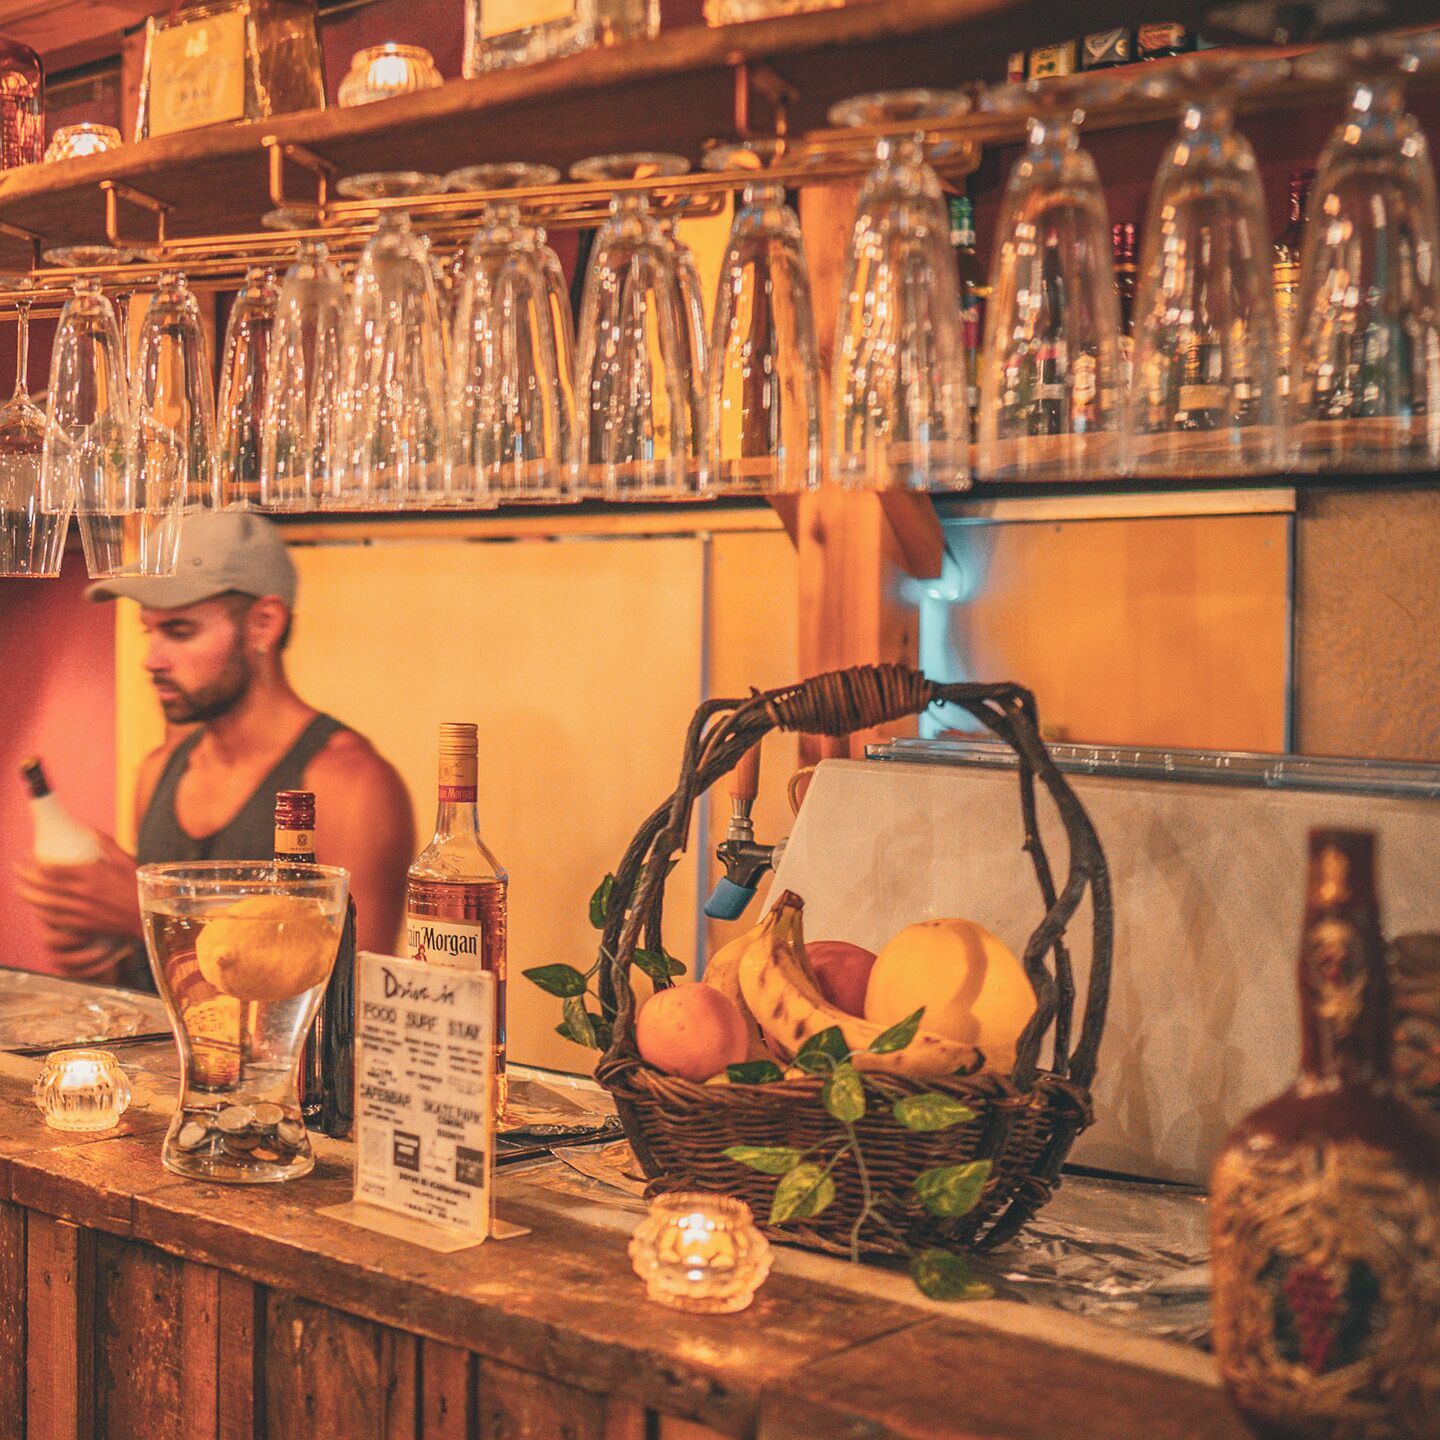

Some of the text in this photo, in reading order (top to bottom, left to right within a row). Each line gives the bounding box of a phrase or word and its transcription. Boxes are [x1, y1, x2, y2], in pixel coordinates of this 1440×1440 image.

[421, 926, 479, 956] Morgan
[381, 966, 429, 1001] Drive
[363, 1001, 397, 1024] FOOD
